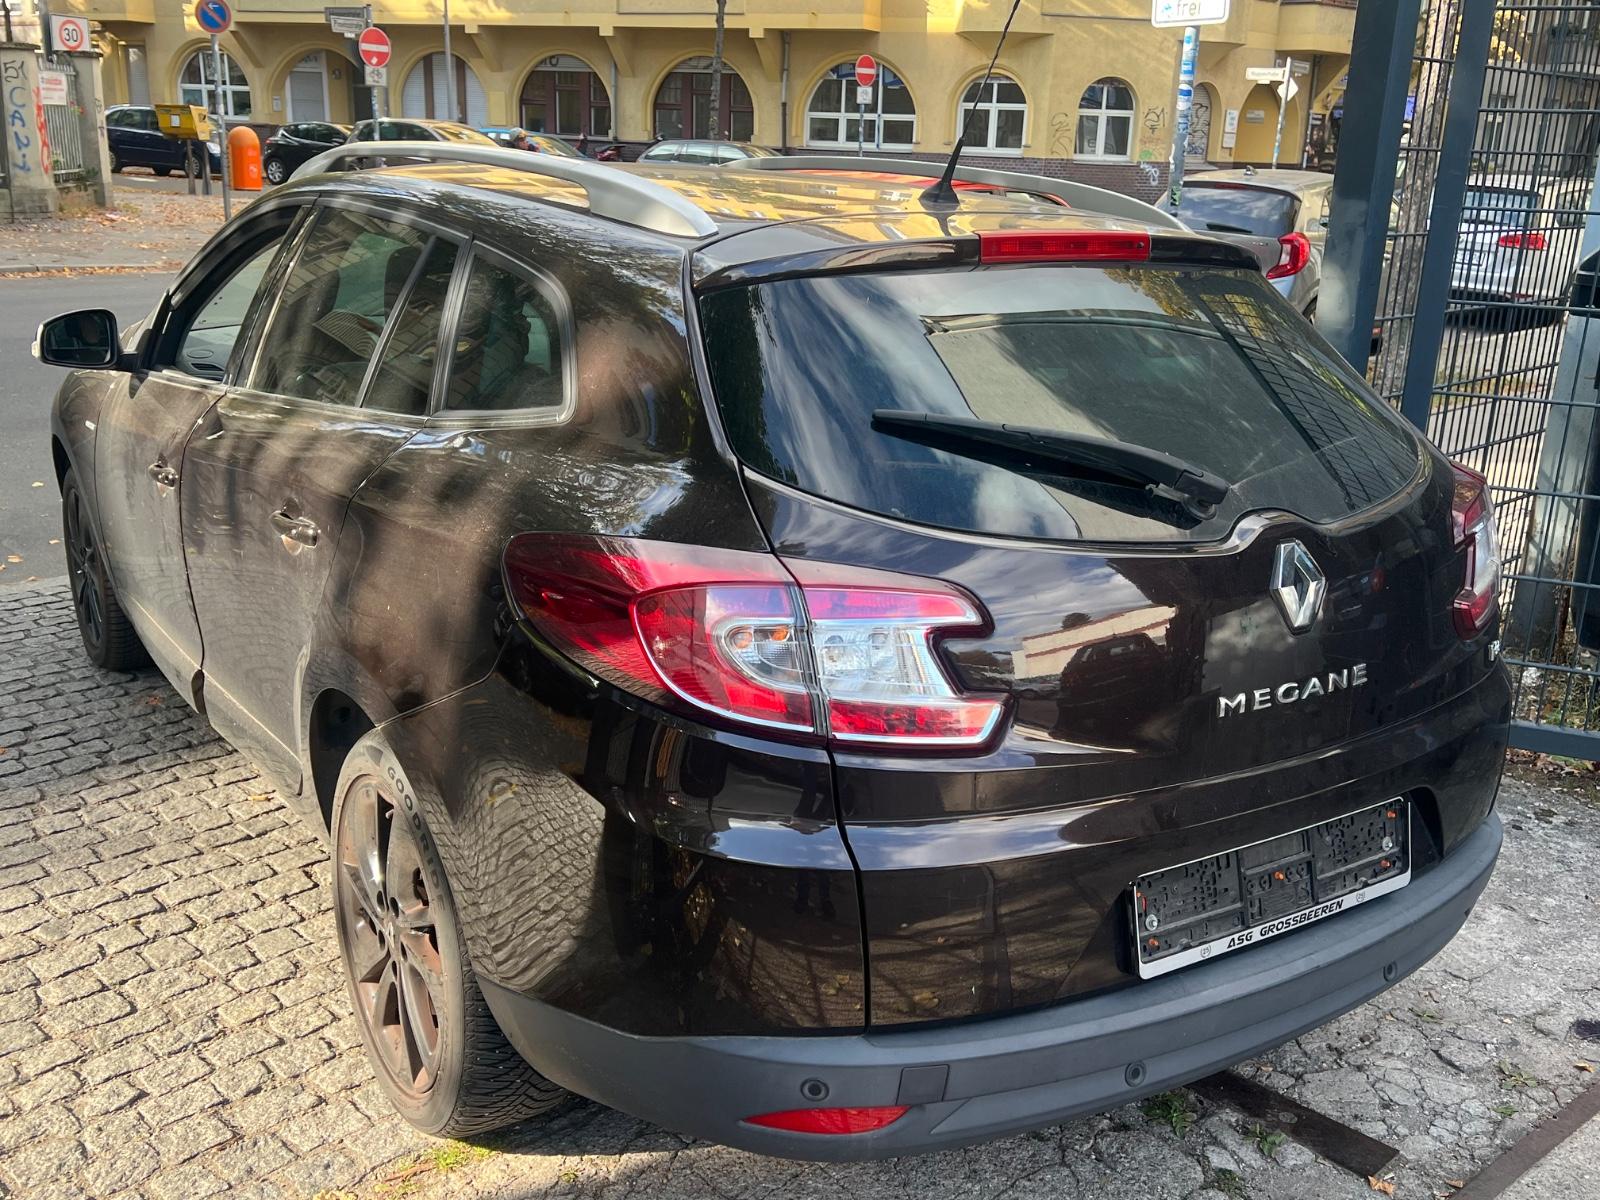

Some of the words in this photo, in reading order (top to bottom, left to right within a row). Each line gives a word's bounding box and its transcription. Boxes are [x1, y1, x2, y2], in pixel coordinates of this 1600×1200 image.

[1176, 0, 1201, 16] frei
[63, 27, 79, 42] 30
[1217, 663, 1368, 717] MEGANE
[1226, 930, 1254, 949] ASG
[1259, 899, 1344, 937] GROSSBEEREN
